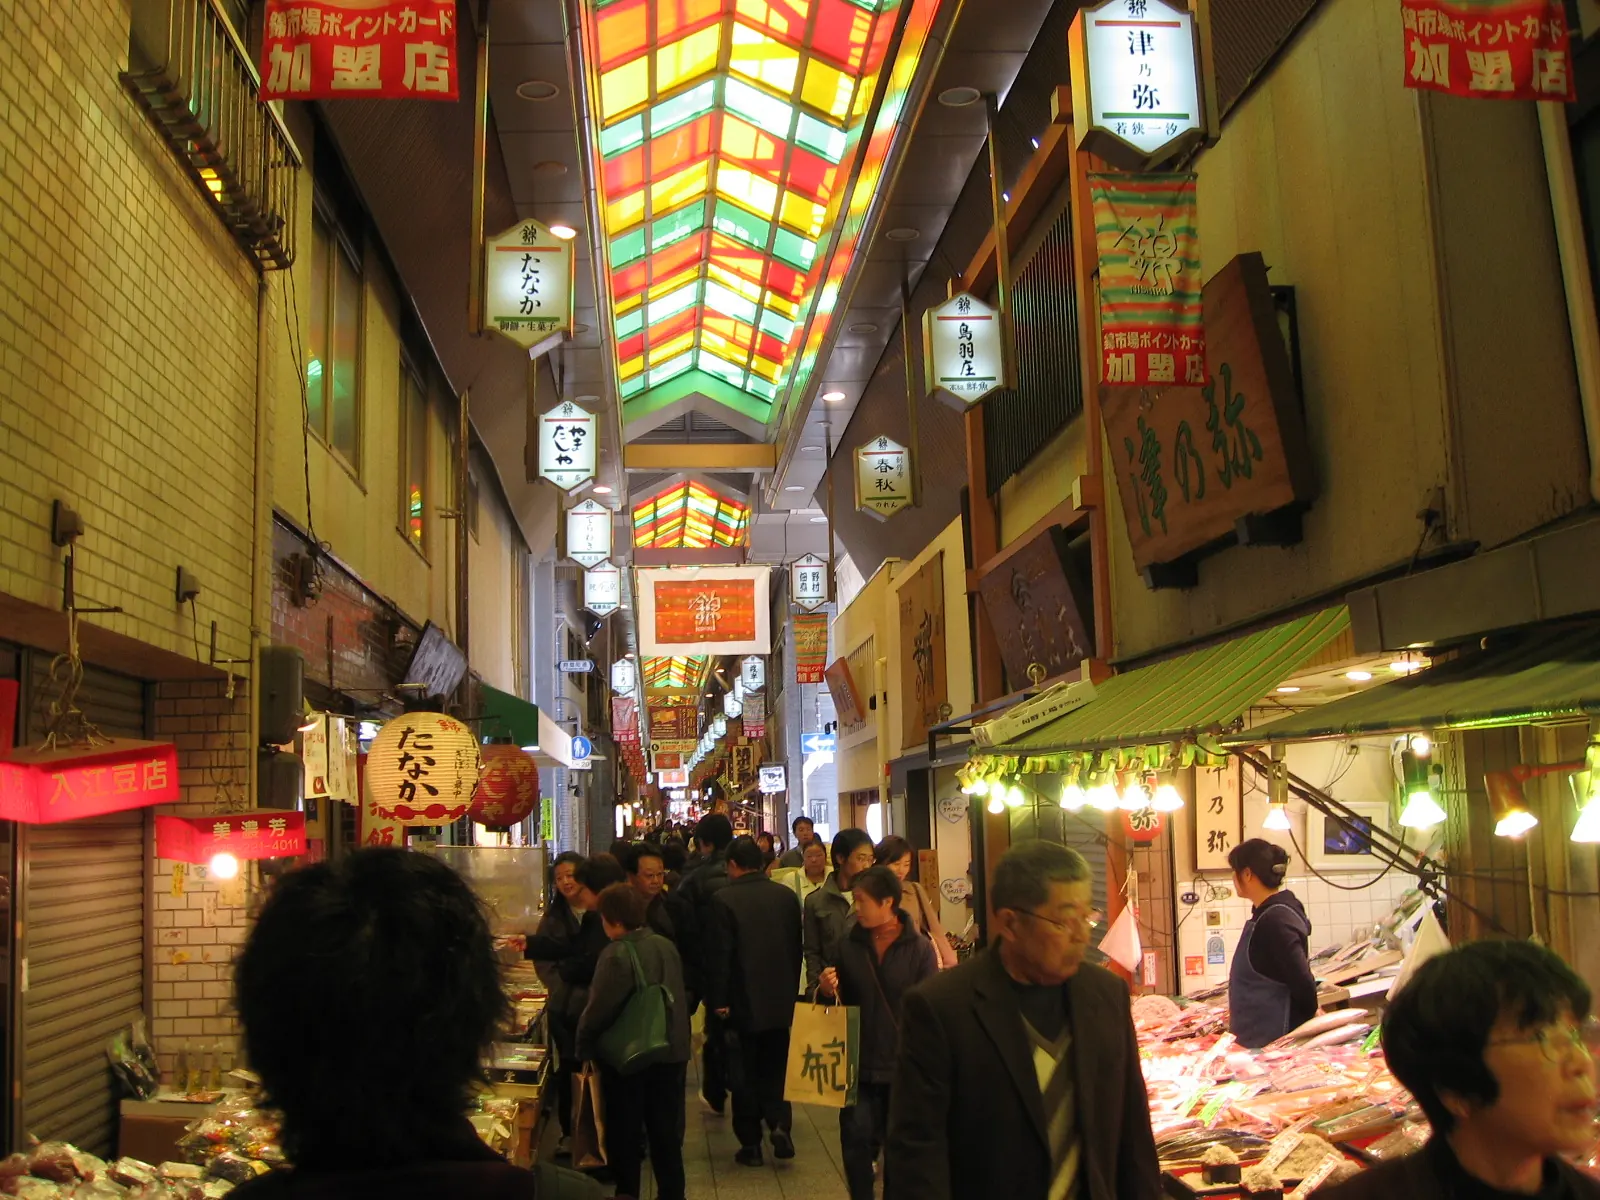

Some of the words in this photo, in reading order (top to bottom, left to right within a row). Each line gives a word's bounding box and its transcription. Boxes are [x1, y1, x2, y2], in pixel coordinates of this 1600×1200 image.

[268, 7, 453, 40] 錦市場ポイントカード
[266, 41, 450, 93] 加盟店
[1127, 30, 1160, 109] 津乃弥
[1410, 36, 1568, 95] 加盟店
[520, 253, 541, 315] たなか
[1106, 353, 1204, 383] 加盟店
[568, 425, 587, 452] やま
[874, 457, 896, 493] 春秋
[49, 759, 167, 806] 入江豆店
[397, 726, 439, 802] たなか
[212, 818, 287, 842] 美濃芳
